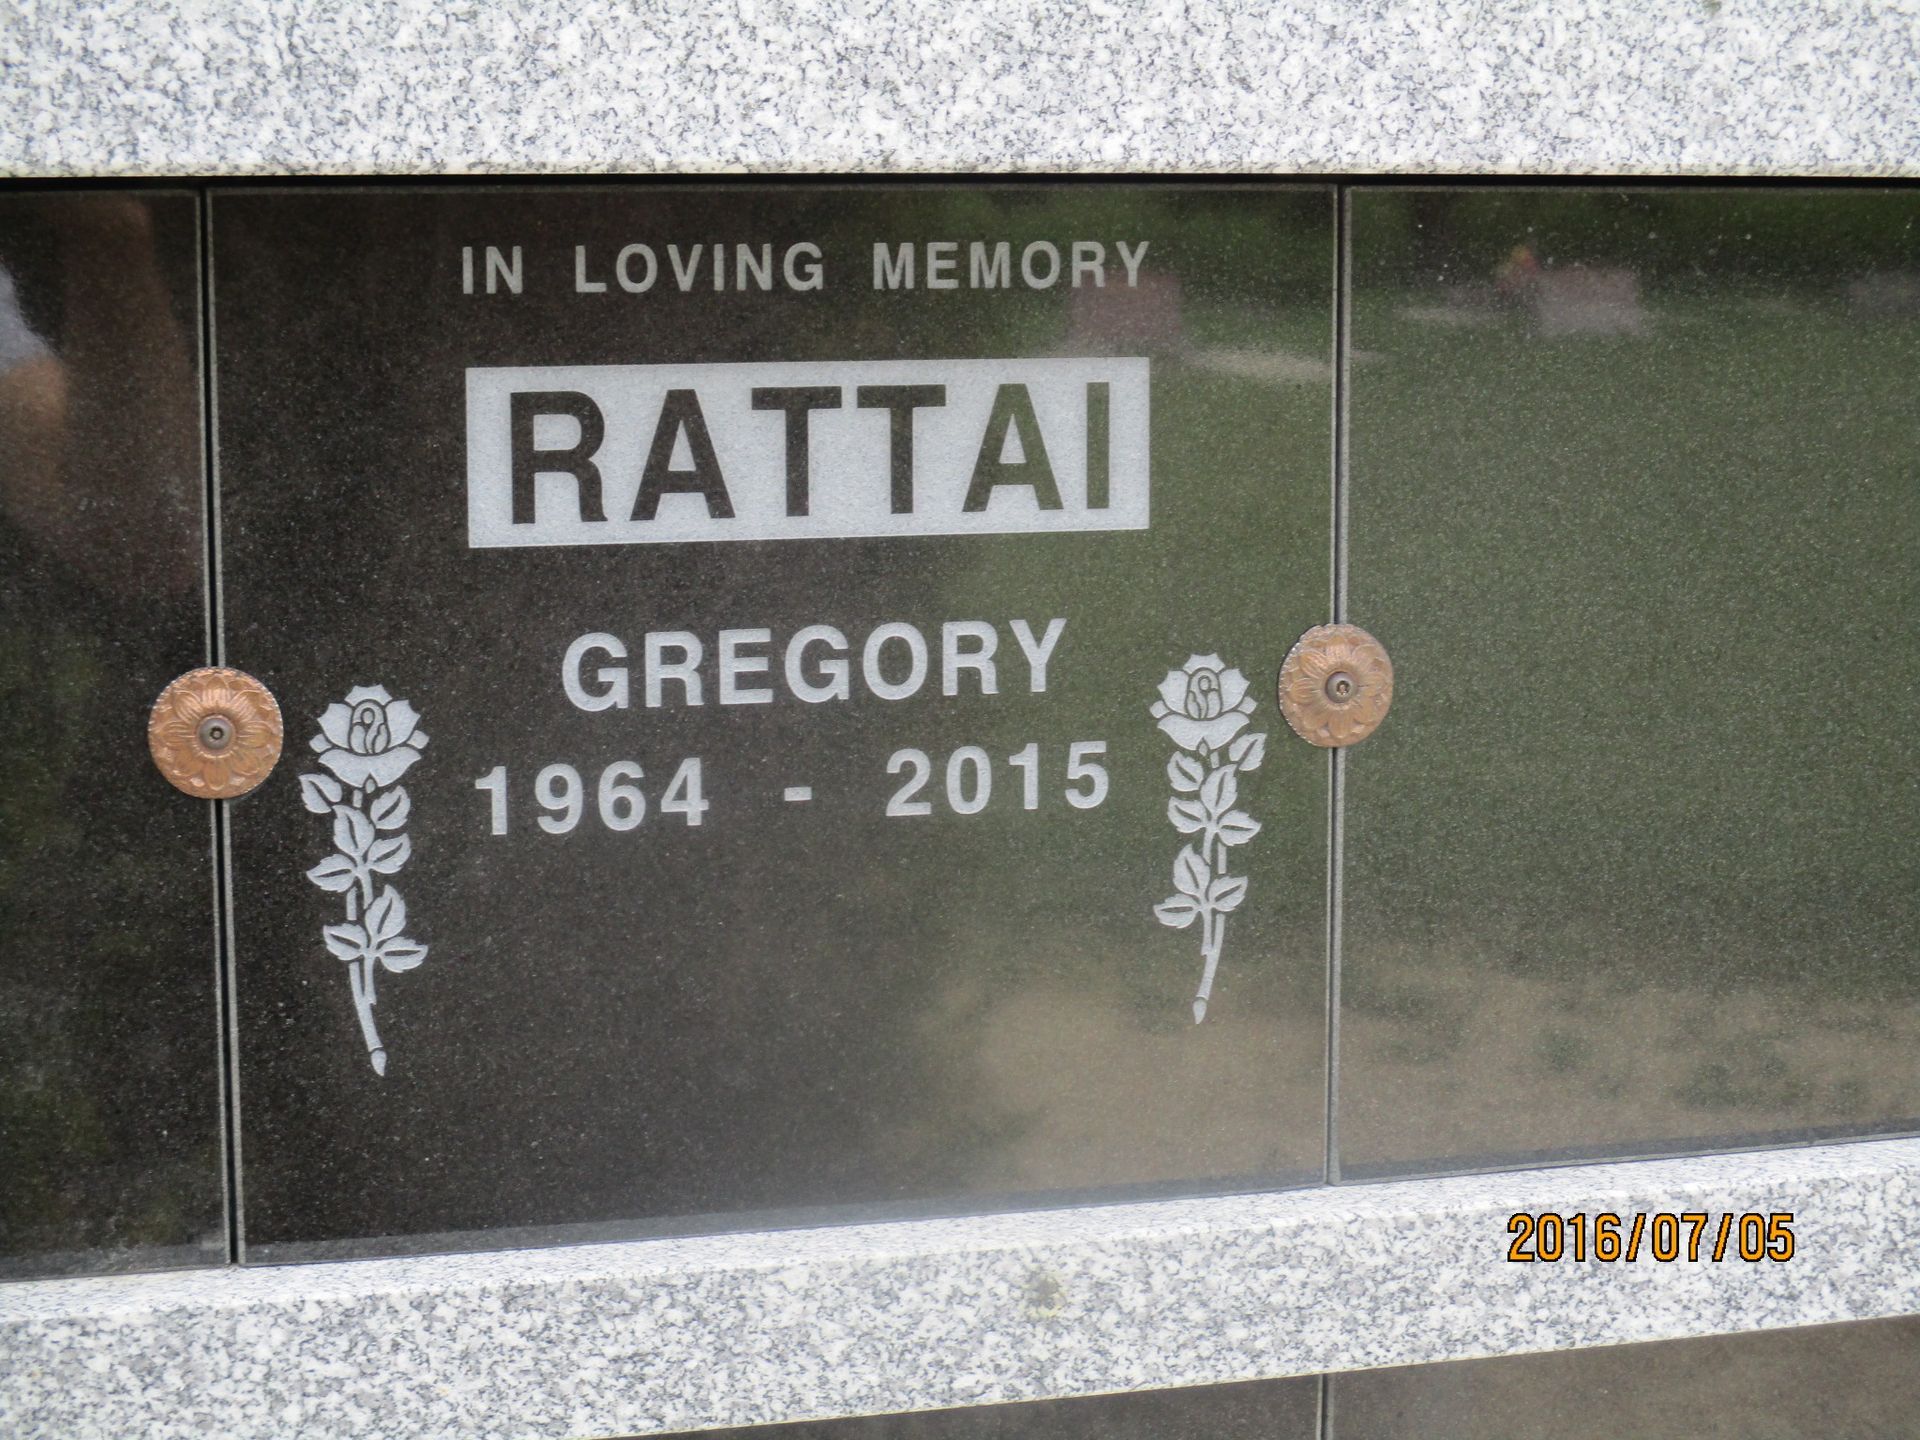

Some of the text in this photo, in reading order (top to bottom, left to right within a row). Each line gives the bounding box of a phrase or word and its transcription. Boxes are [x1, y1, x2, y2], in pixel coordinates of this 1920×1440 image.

[461, 240, 1148, 296] IN LOVING MEMORY
[510, 383, 1109, 525] RATTAI
[562, 618, 1067, 712] GREGORY
[475, 740, 1109, 836] 1964 - 2015
